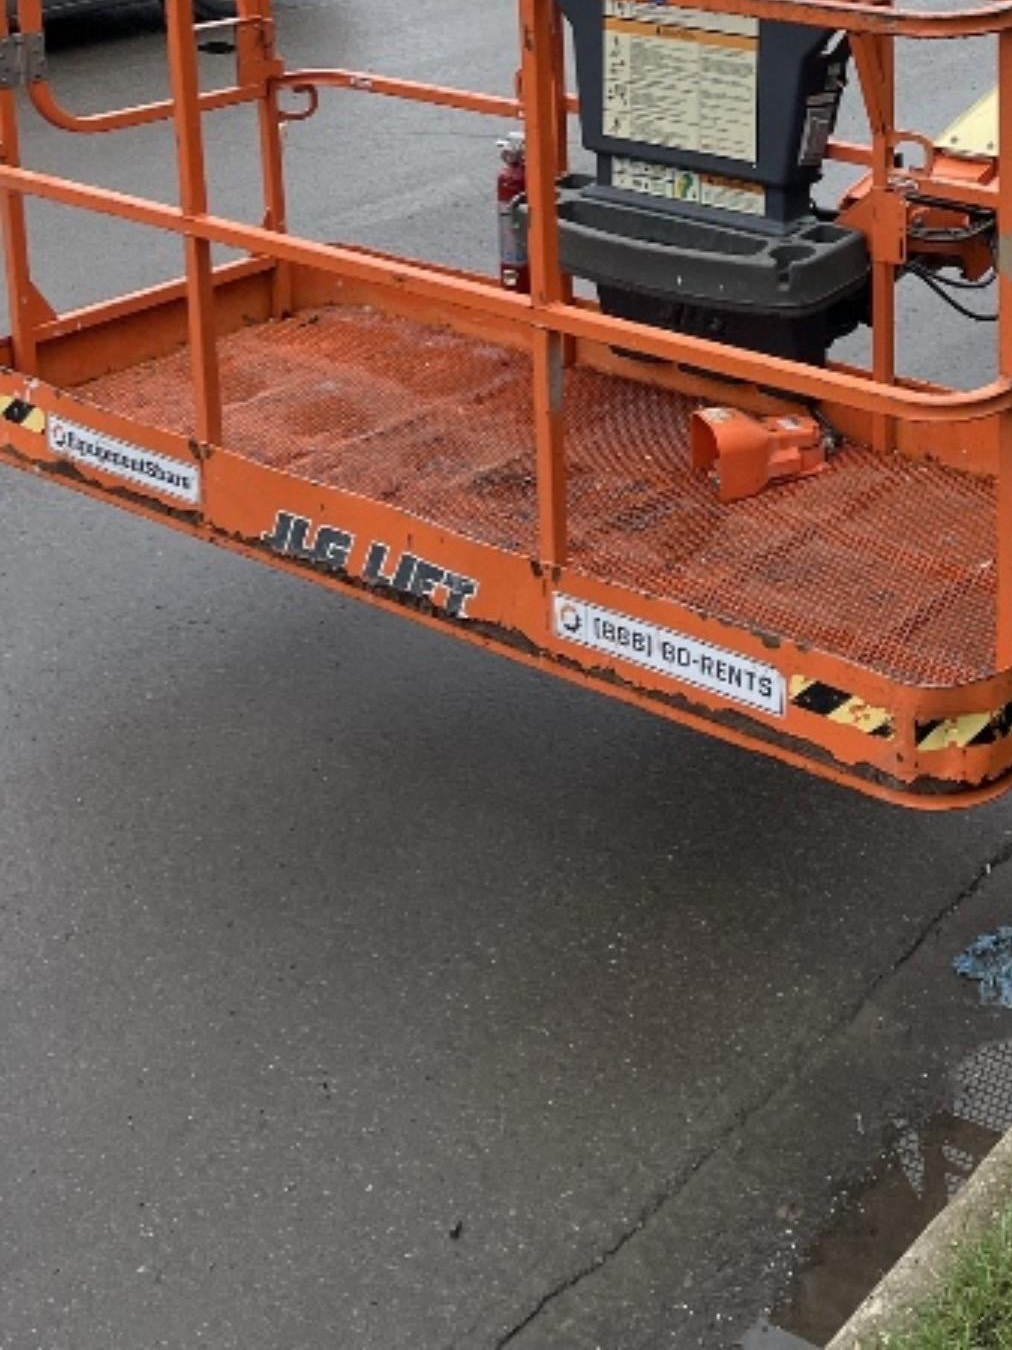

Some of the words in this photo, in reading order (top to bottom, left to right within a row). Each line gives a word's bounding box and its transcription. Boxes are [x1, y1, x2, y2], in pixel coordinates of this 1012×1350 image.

[67, 431, 192, 491] EquipmentShare
[261, 510, 355, 570] JLG
[363, 541, 479, 618] LIFT
